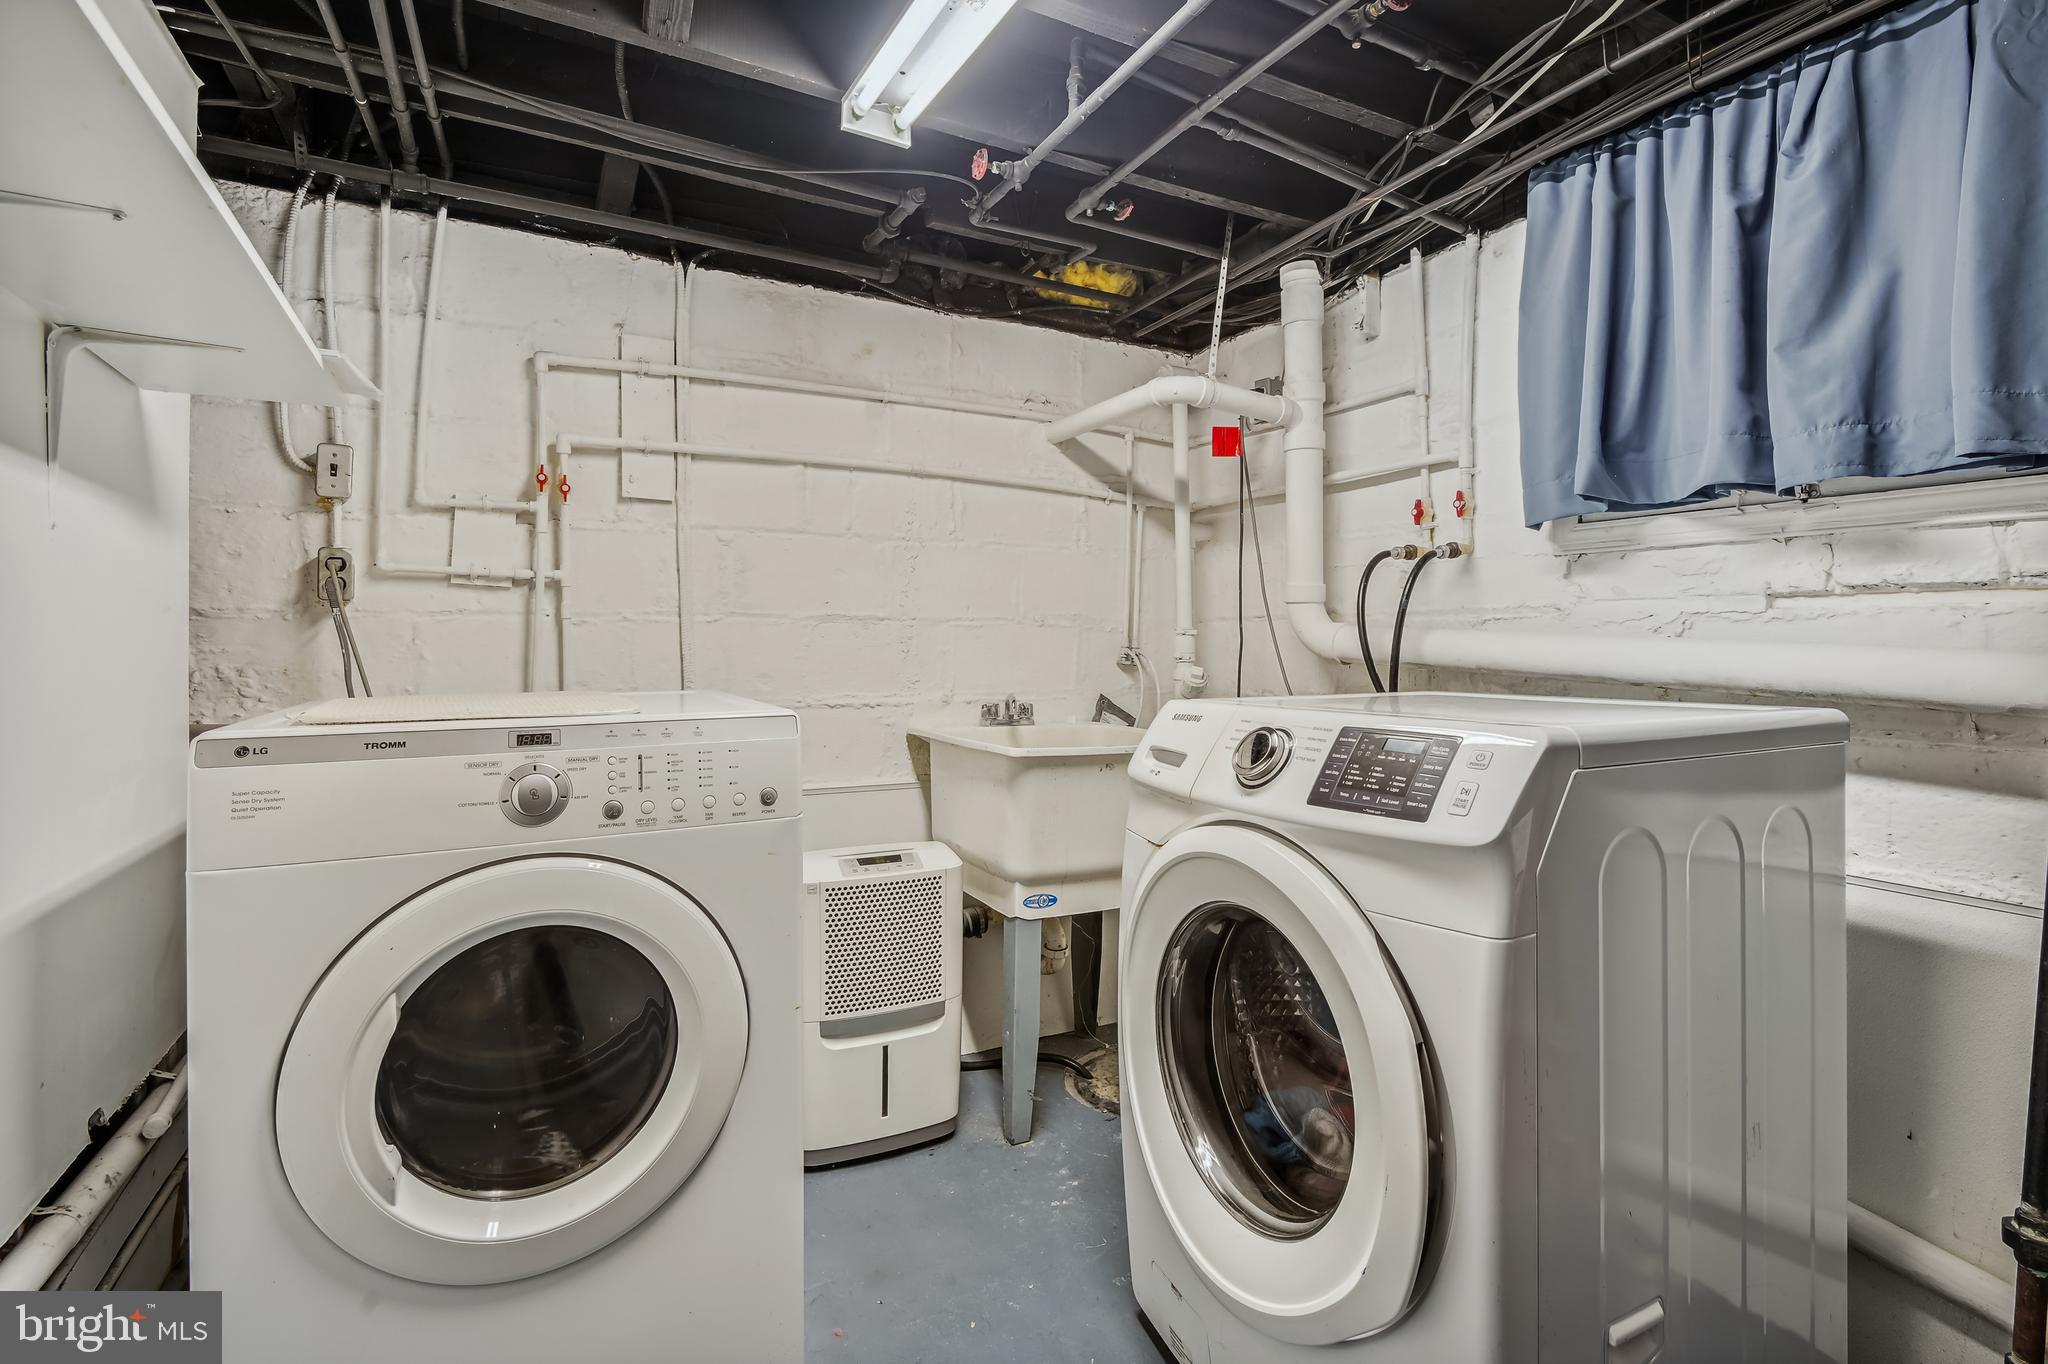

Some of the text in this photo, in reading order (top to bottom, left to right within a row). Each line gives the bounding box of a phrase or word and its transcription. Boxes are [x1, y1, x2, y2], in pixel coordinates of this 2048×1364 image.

[1171, 713, 1203, 723] SAMSUNG
[363, 741, 407, 750] TROMM
[252, 747, 269, 756] LG
[251, 789, 281, 797] Capacity
